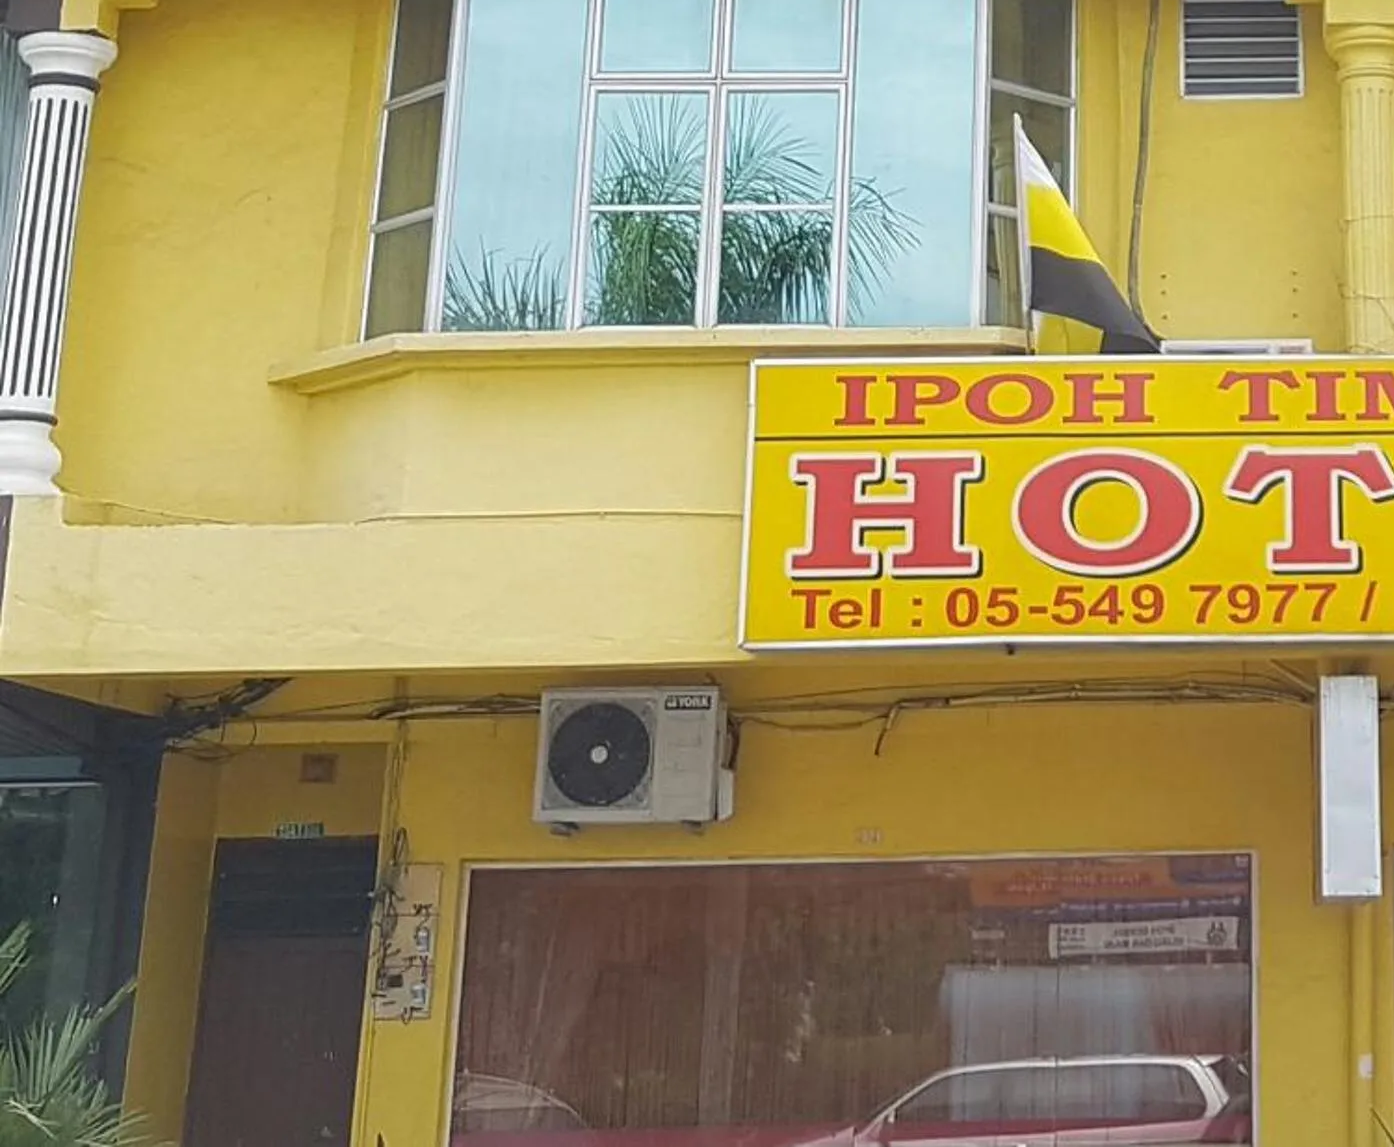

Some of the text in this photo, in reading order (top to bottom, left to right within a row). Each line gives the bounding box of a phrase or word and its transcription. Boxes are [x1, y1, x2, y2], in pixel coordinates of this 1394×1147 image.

[833, 372, 1156, 427] IPOH
[945, 585, 1165, 628] 05-549
[1188, 582, 1339, 625] 7977
[1360, 581, 1376, 622] /
